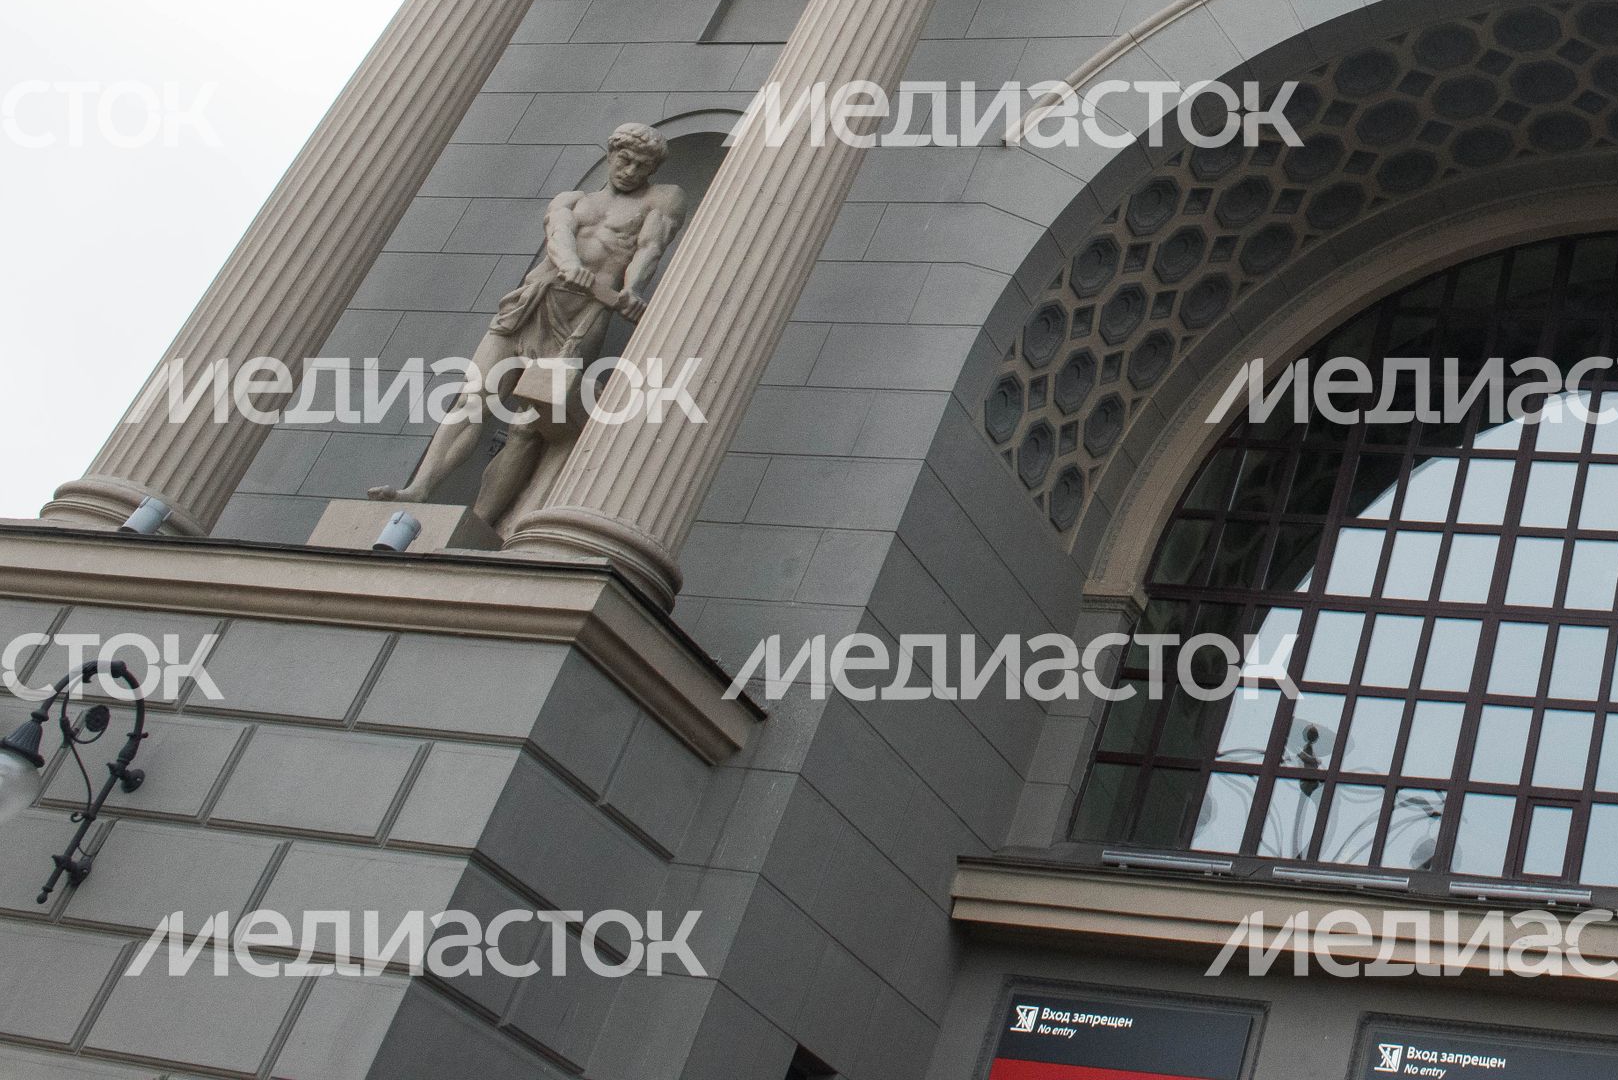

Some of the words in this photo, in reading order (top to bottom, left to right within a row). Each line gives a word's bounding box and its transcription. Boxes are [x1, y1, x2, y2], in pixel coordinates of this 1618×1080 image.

[1041, 1007, 1070, 1024] Вход
[1072, 1012, 1133, 1029] запрещен
[1037, 1024, 1050, 1035] No
[1051, 1026, 1077, 1039] entry
[1407, 1046, 1438, 1063] Вход
[1440, 1051, 1506, 1069] запрещен
[1404, 1064, 1418, 1075] No
[1420, 1066, 1446, 1079] entry
